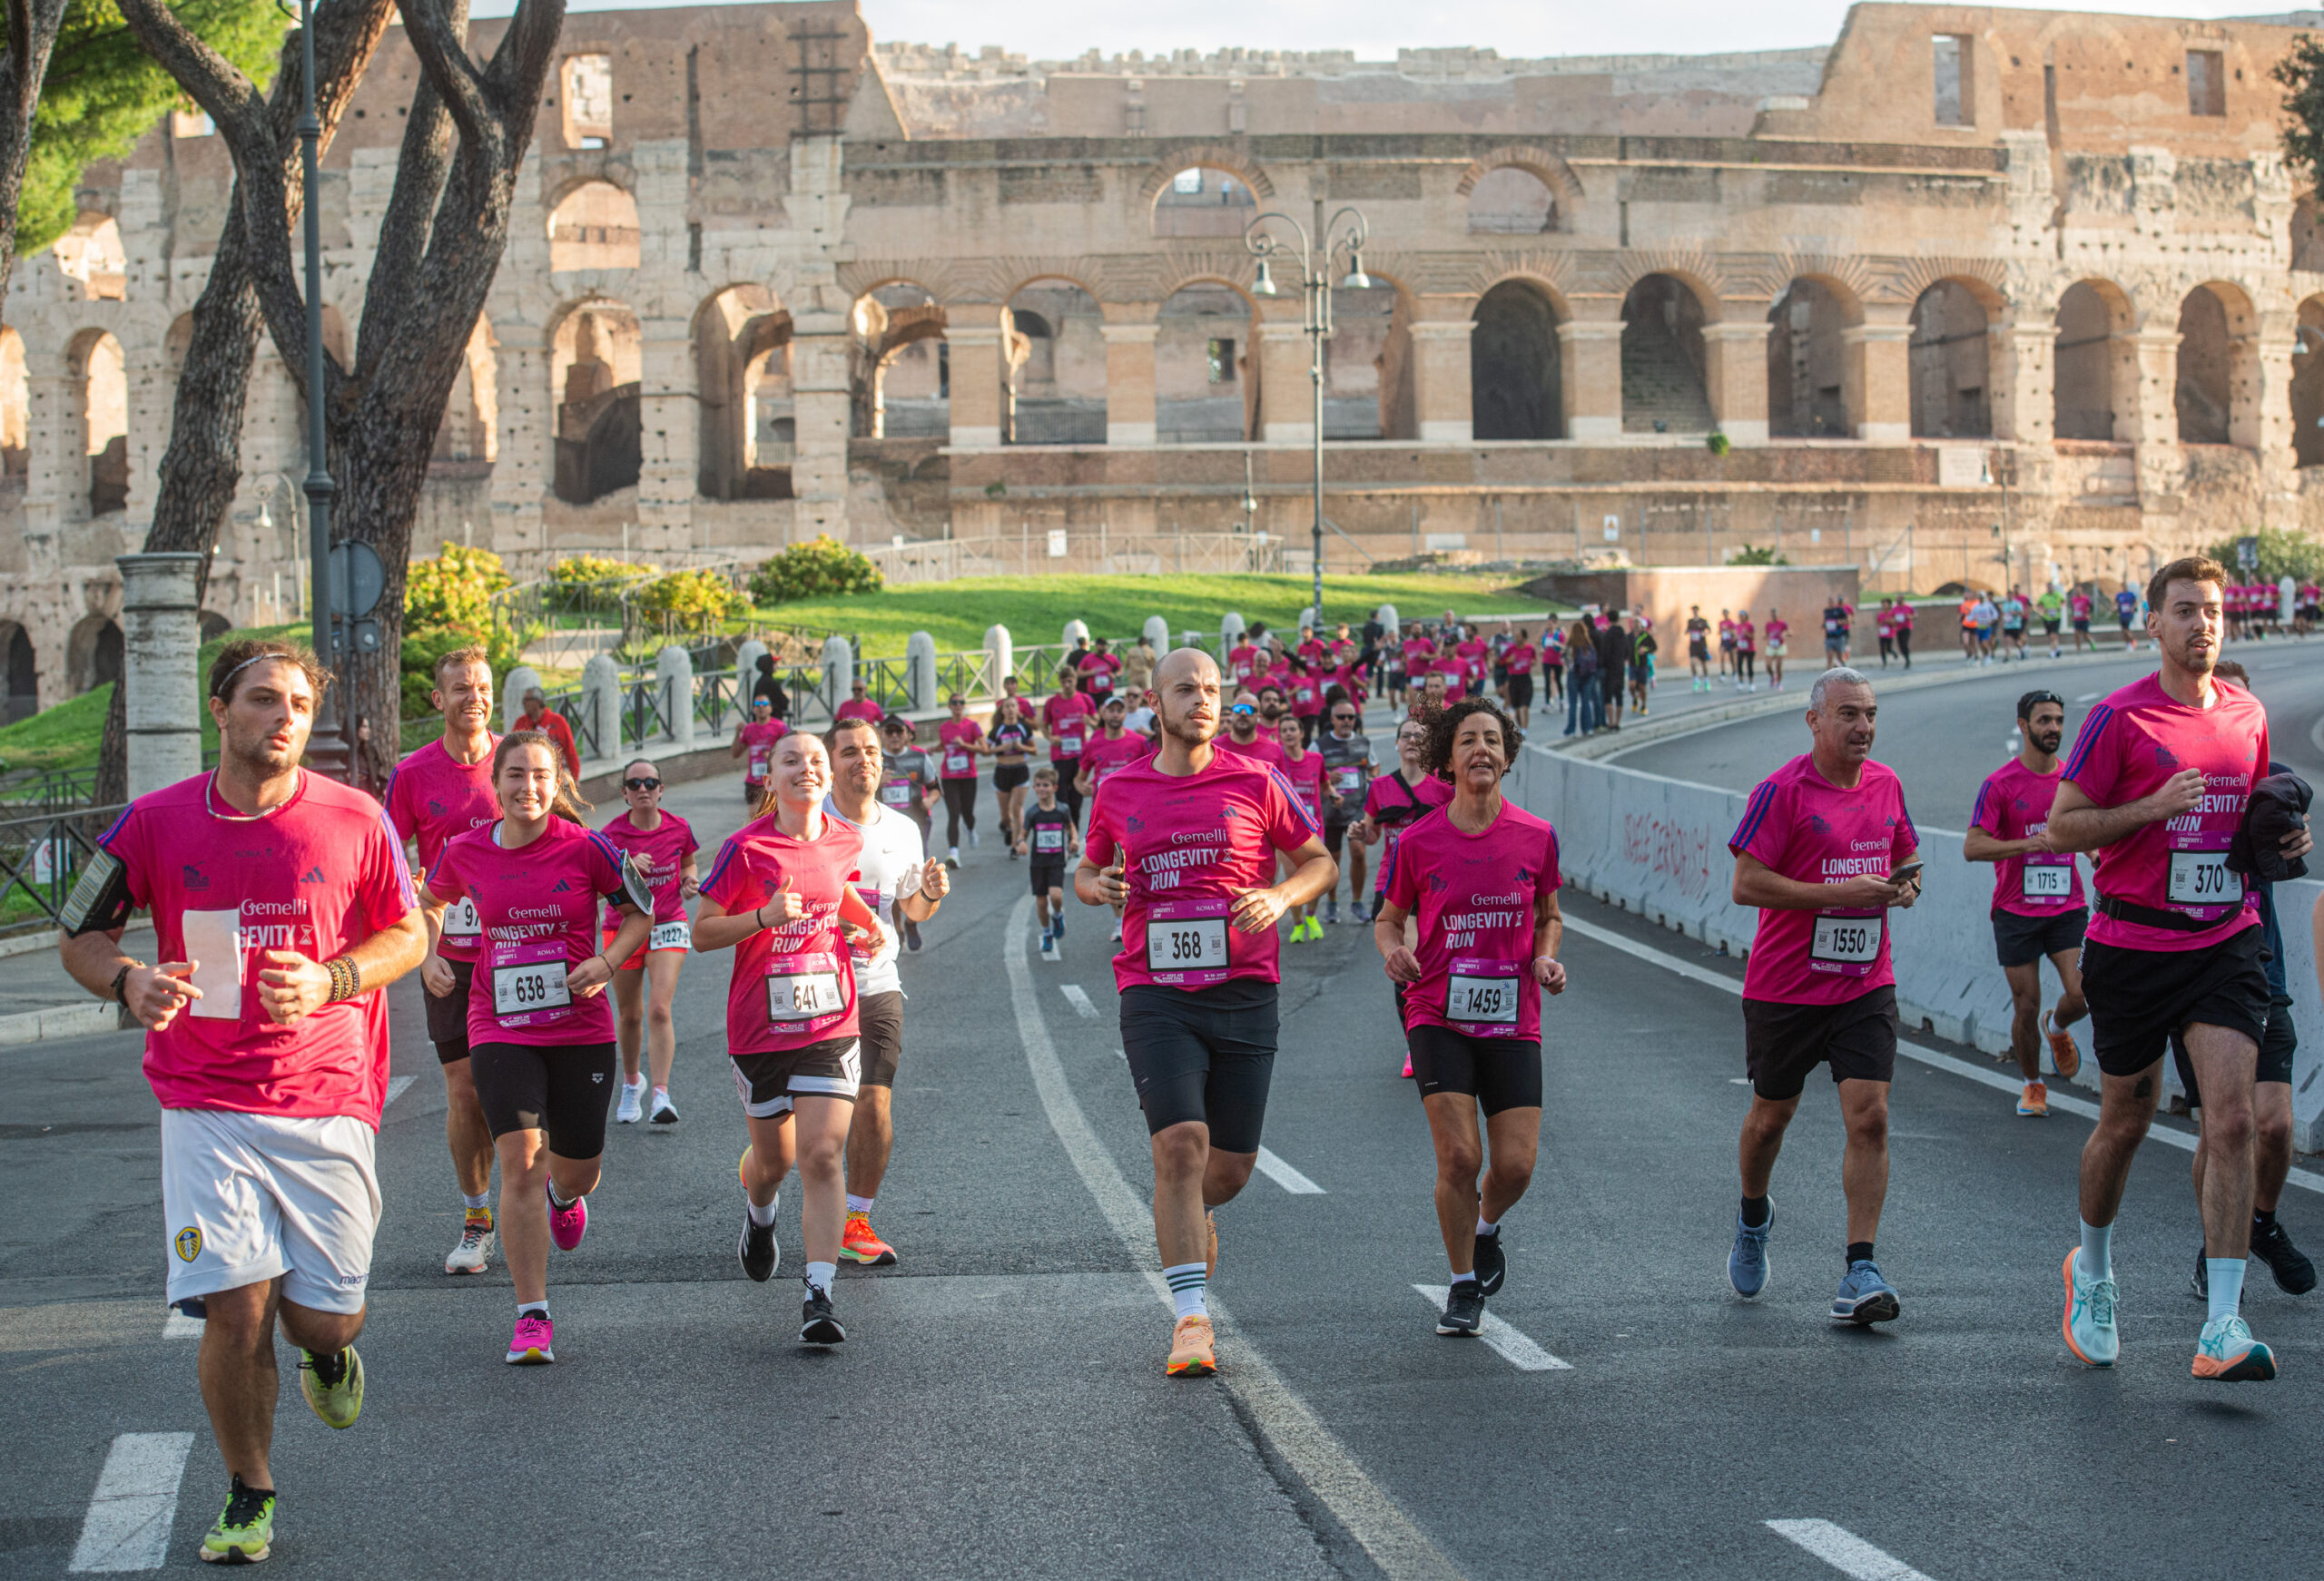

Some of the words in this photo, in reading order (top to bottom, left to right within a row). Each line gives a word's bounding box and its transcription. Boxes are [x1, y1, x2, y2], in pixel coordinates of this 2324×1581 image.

[2203, 772, 2250, 787] Gemelli
[2189, 794, 2240, 813] GEVITY
[2165, 815, 2202, 832] RUN
[1171, 829, 1227, 845] Gemelli
[1850, 836, 1890, 852] Gemelli
[1141, 848, 1219, 874] LONGEVITY
[1821, 857, 1885, 876] LONGEVITY
[1149, 869, 1181, 891] RUN
[2037, 872, 2058, 889] 1715
[2194, 864, 2224, 894] 370
[241, 899, 307, 916] Gemelli
[806, 899, 839, 914] Geme
[1471, 892, 1521, 907] Gemelli
[508, 904, 562, 919] Gemelli
[1442, 911, 1513, 931] LONGEVITY
[239, 924, 296, 948] GEVITY
[487, 923, 556, 941] LONGEVITY
[662, 928, 683, 944] 1227
[1445, 931, 1476, 950] RUN
[1833, 928, 1866, 954] 1550
[771, 937, 805, 954] RUN
[1171, 930, 1203, 960] 368
[516, 974, 546, 1003] 638
[793, 985, 819, 1011] 641
[1467, 987, 1502, 1014] 1459
